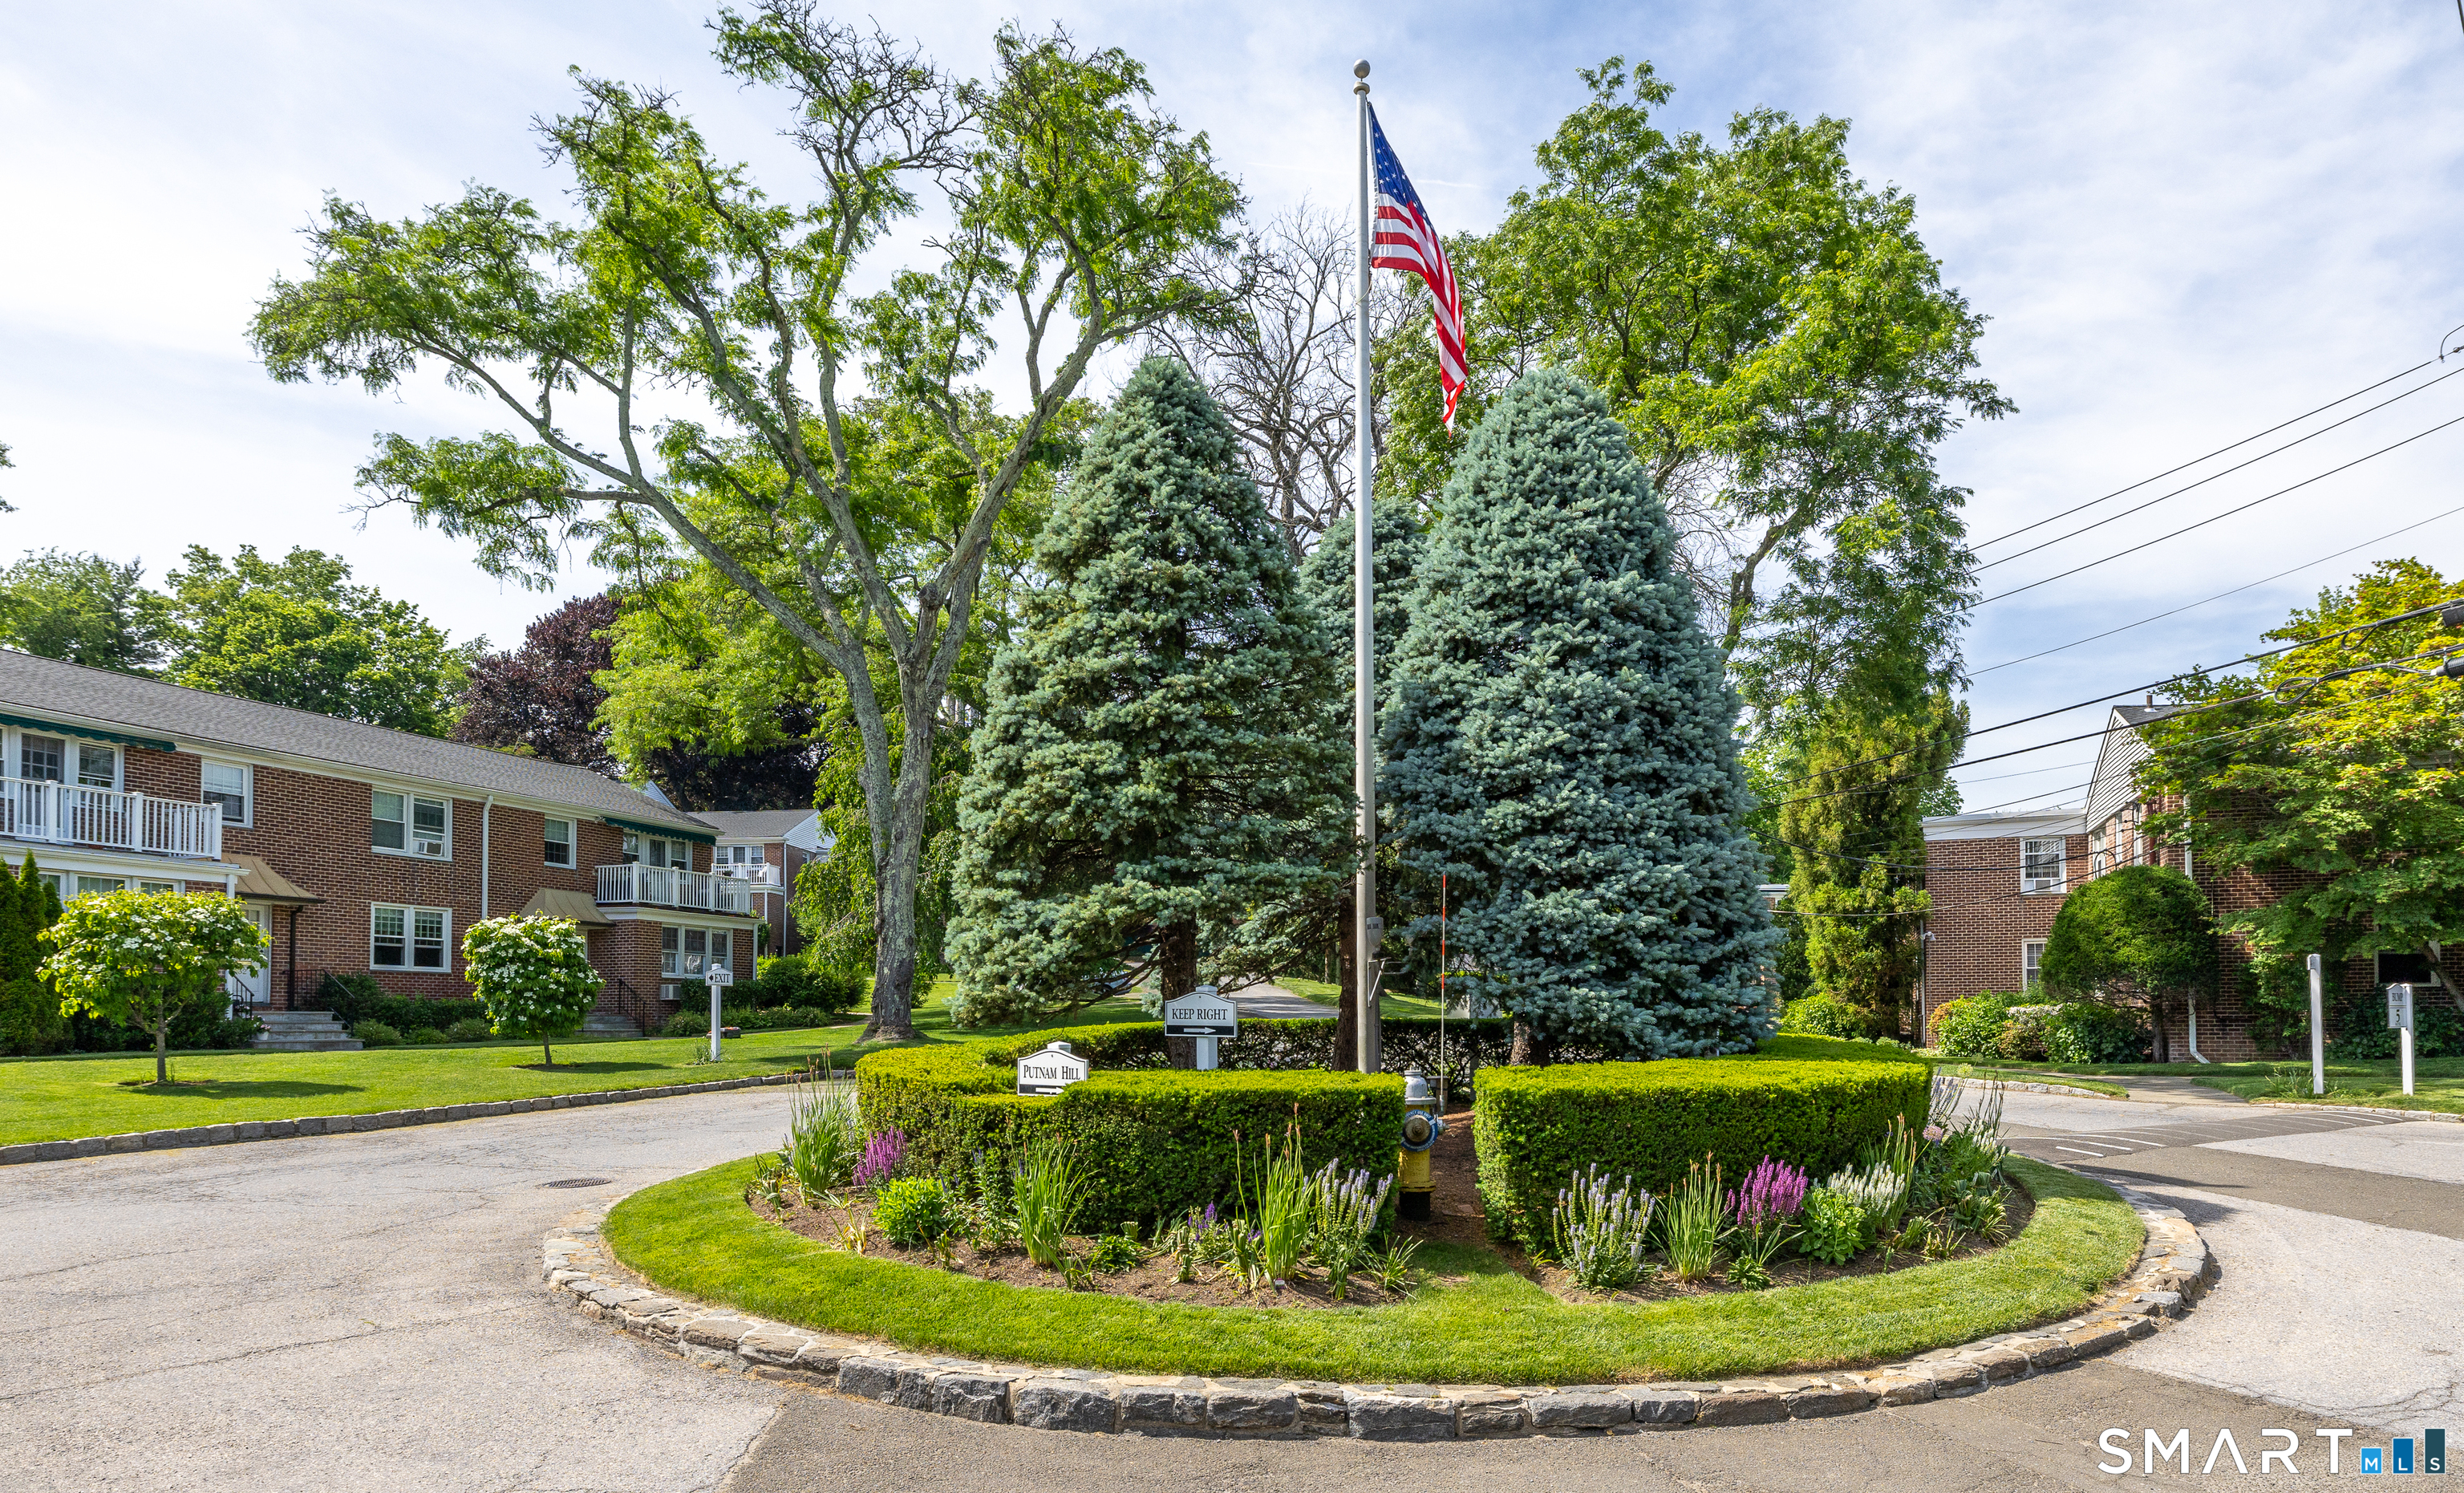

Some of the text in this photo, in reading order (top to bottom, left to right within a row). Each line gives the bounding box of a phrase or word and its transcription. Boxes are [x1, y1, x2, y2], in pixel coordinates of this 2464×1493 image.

[715, 973, 730, 983] EXIT
[2392, 992, 2403, 1002] BUMP
[1172, 1008, 1228, 1020] KEEP RIGHT
[2396, 1009, 2401, 1023] 5
